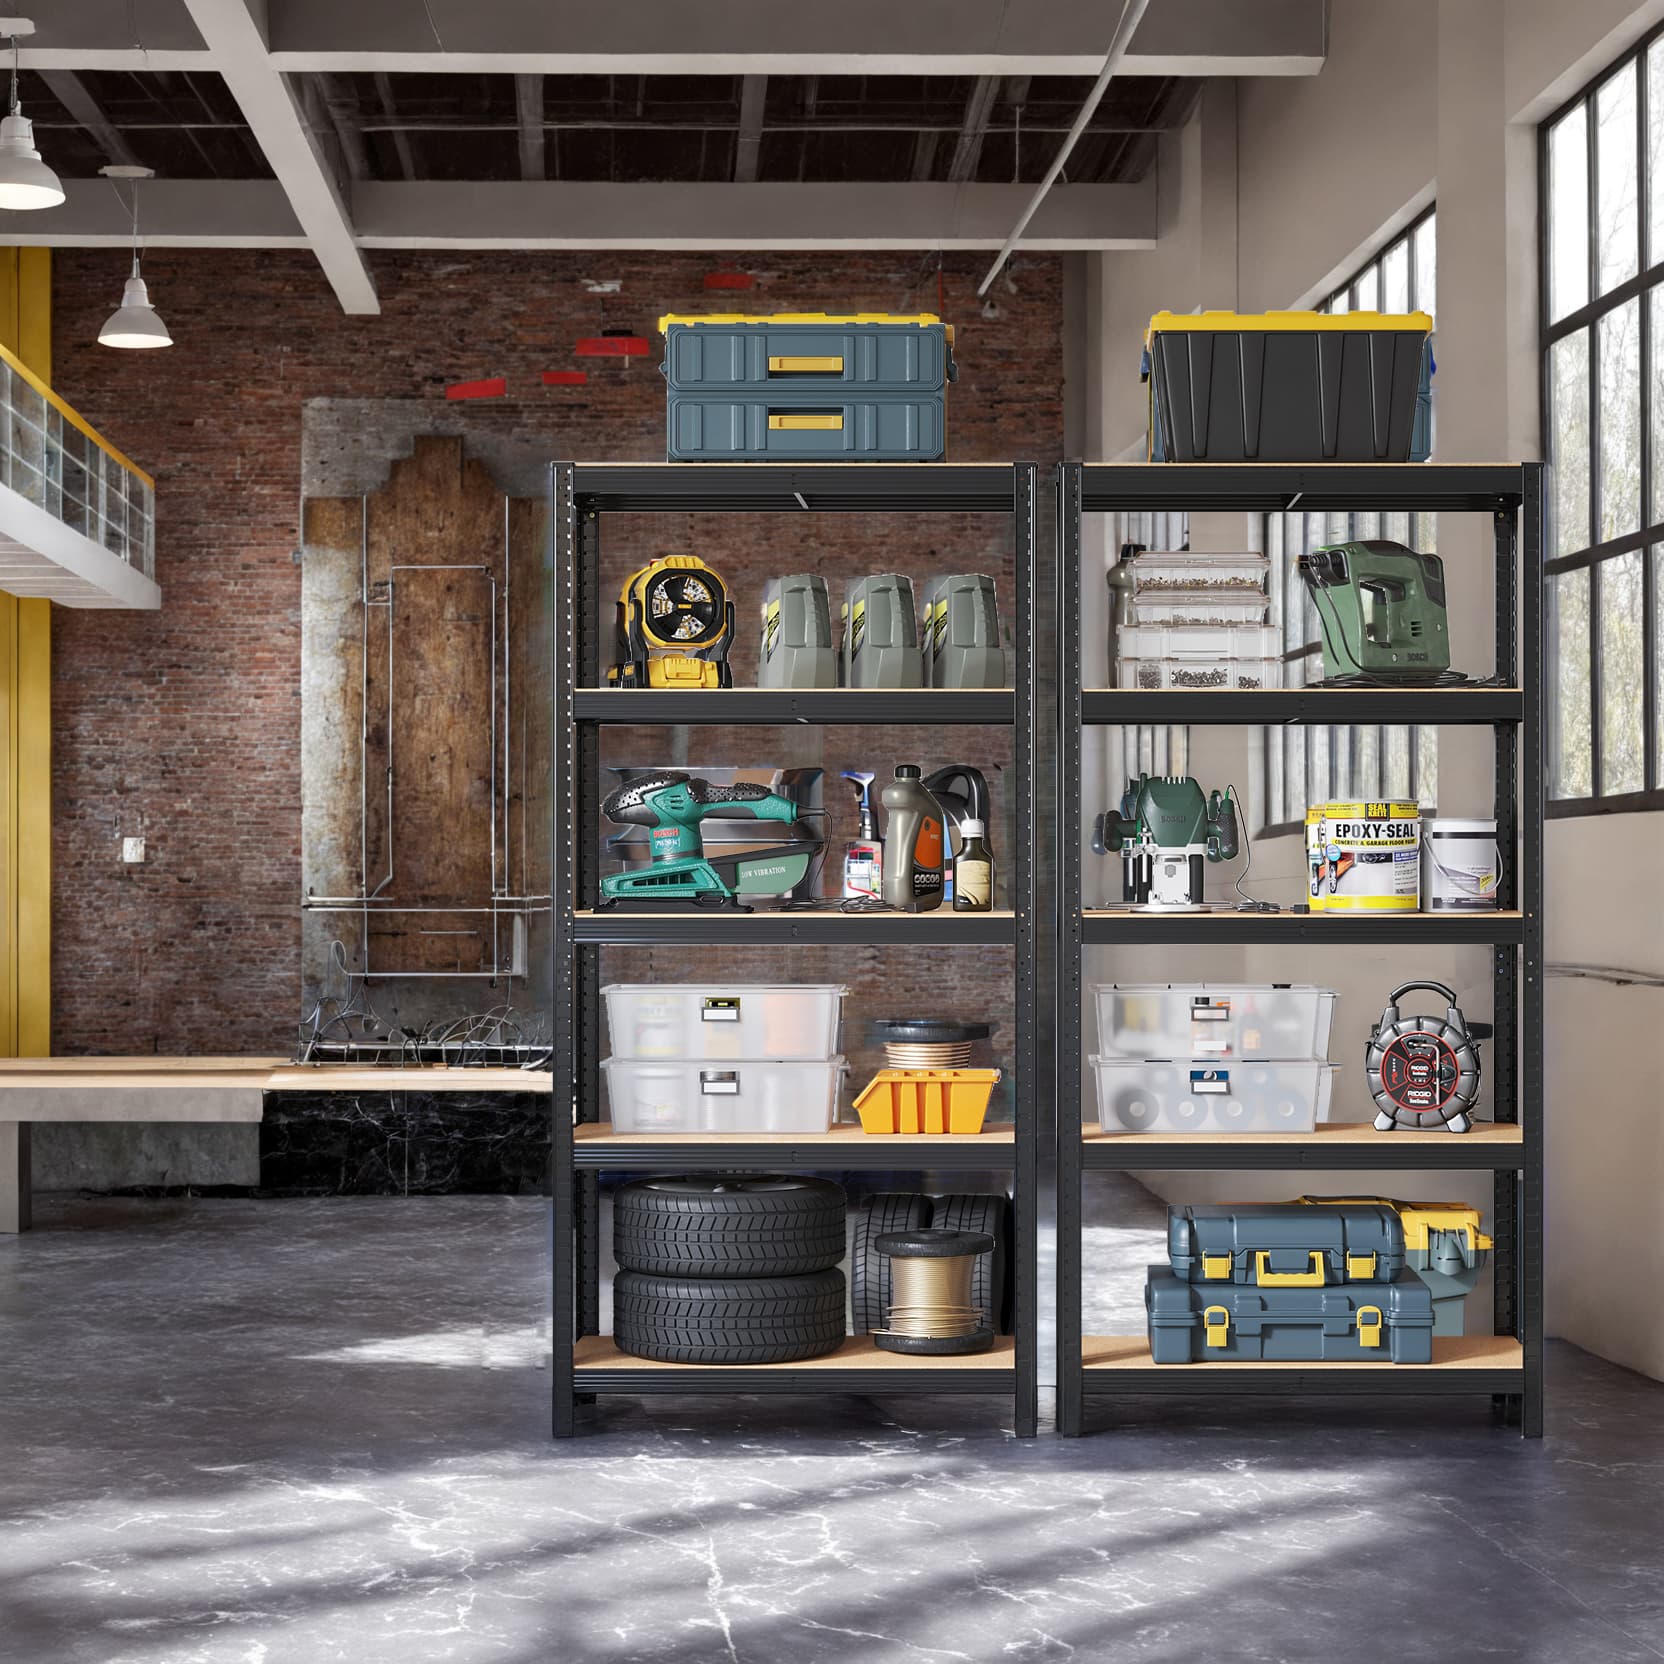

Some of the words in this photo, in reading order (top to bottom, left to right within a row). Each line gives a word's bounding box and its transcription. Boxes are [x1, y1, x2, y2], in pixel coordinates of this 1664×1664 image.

[1336, 823, 1415, 838] EPOXY-SEAL
[741, 870, 753, 879] LOW
[753, 866, 786, 877] VIBRATION
